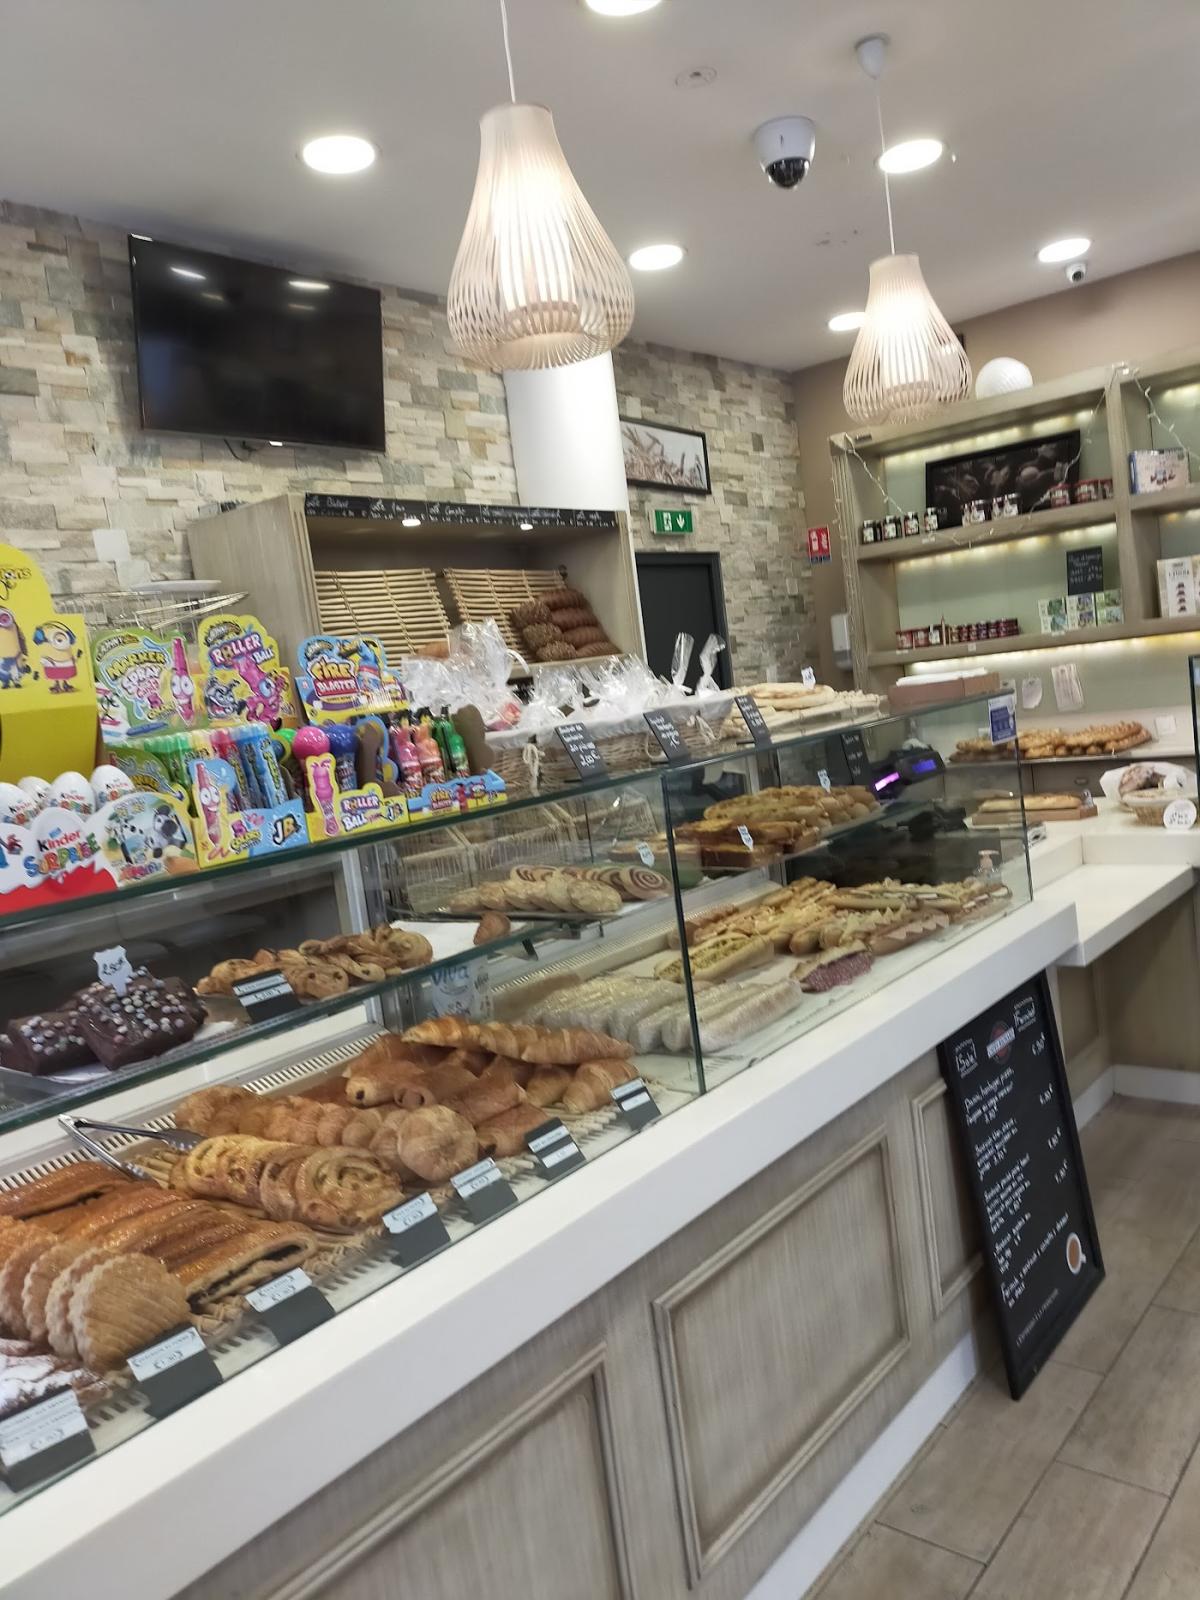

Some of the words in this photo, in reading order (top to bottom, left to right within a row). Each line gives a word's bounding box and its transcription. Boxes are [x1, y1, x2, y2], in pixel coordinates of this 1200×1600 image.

[211, 632, 262, 665] ROLLER
[253, 646, 275, 665] BALL
[106, 651, 166, 680] MARKER
[310, 660, 353, 681] FIRE
[121, 664, 162, 696] SPRAY
[315, 679, 358, 696] BLASTER
[342, 795, 379, 812] ROLLER
[272, 814, 300, 846] JB
[341, 812, 368, 832] BALL
[37, 831, 81, 852] kinder
[23, 832, 101, 878] SURPRISE
